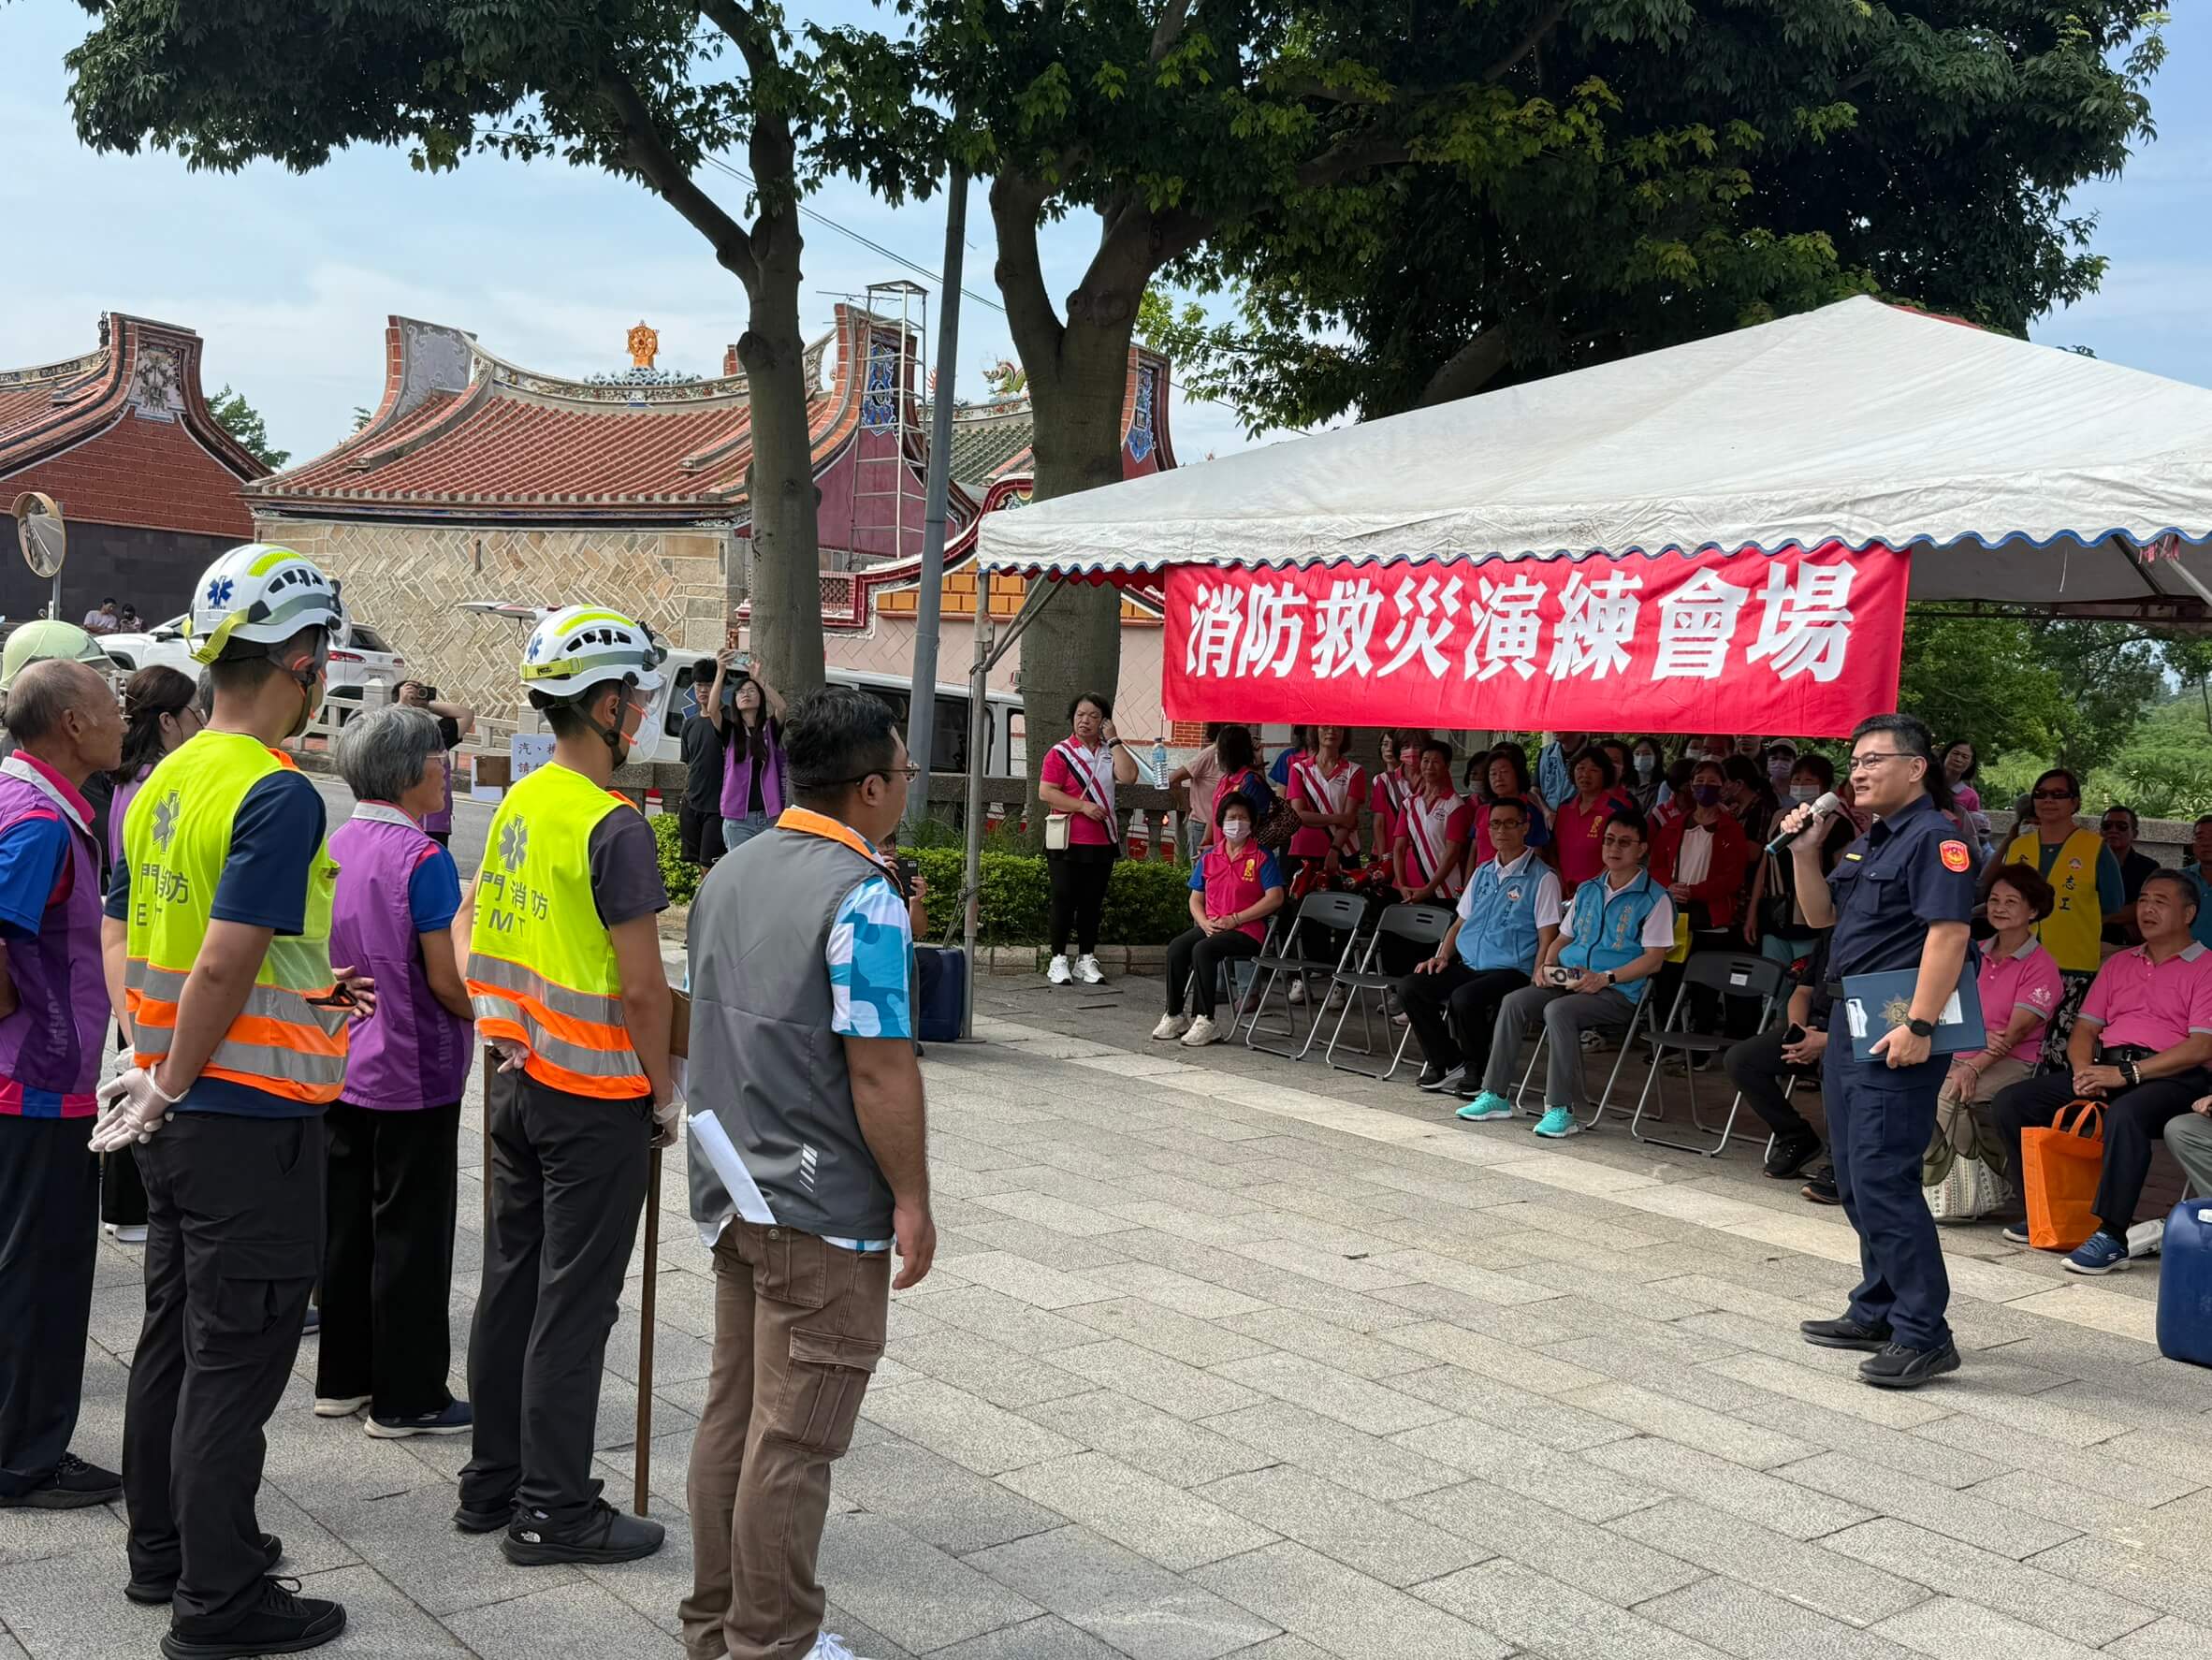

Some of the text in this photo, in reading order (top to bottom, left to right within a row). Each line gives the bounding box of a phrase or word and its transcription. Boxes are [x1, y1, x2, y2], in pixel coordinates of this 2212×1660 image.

[1186, 560, 1857, 682] 消防救災演練會場
